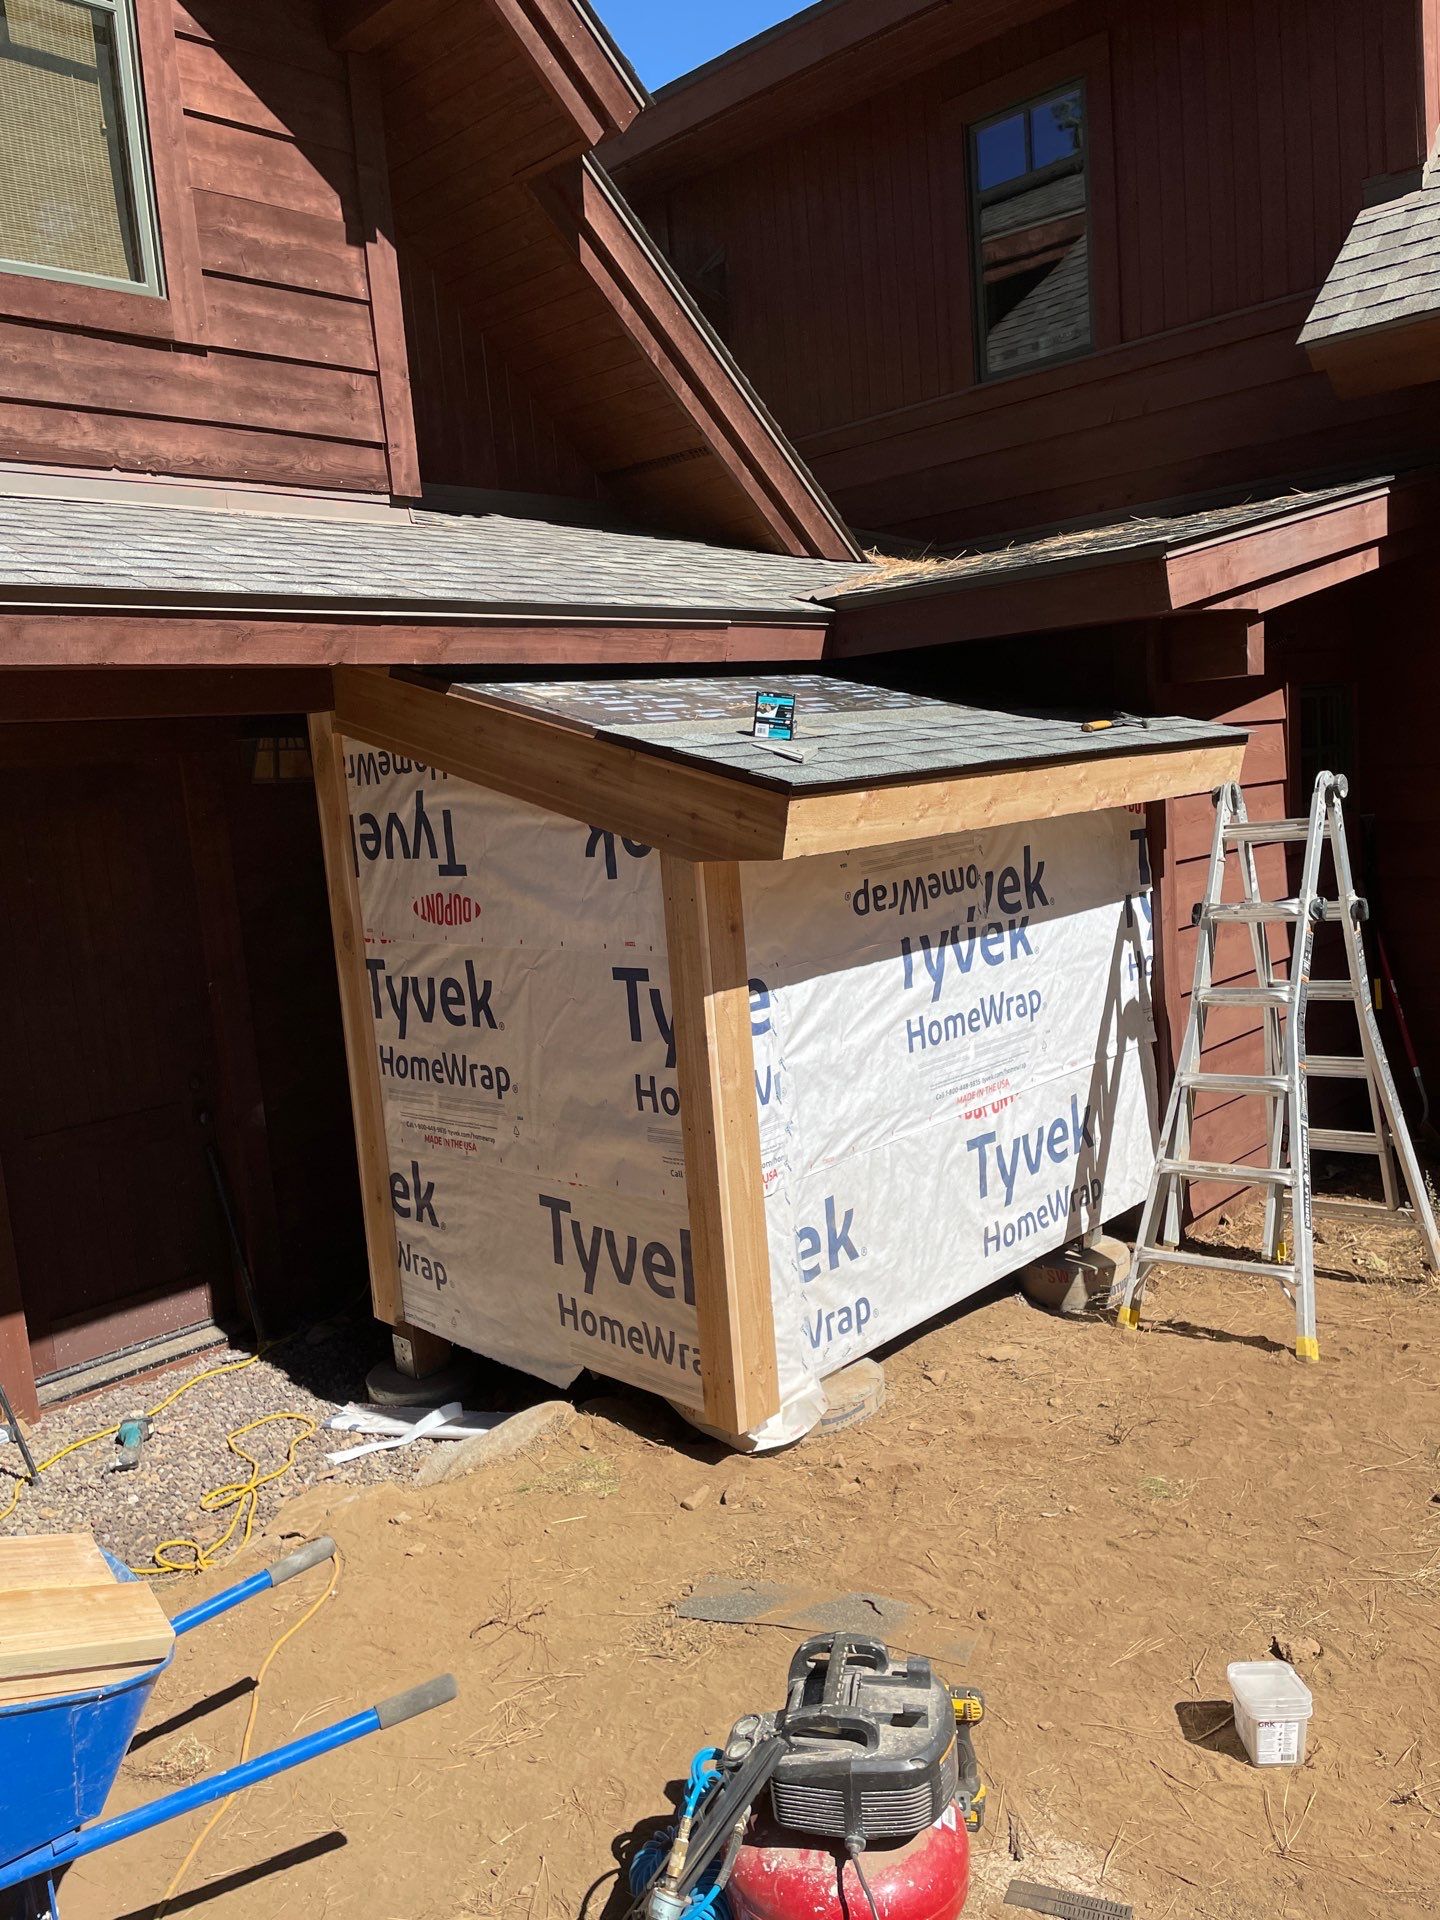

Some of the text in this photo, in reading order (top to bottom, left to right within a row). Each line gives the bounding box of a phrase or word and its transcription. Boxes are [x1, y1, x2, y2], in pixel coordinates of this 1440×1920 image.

[349, 790, 468, 878] Tyve
[420, 893, 472, 926] DUPONT
[366, 958, 498, 1040] Tyvek
[906, 989, 1042, 1053] HomeWrap
[379, 1045, 511, 1100] HomeWrap
[424, 1135, 442, 1147] MADE
[463, 1142, 477, 1152] USA
[966, 1093, 1094, 1207] Tyvek
[983, 1178, 1102, 1258] HomeWrap
